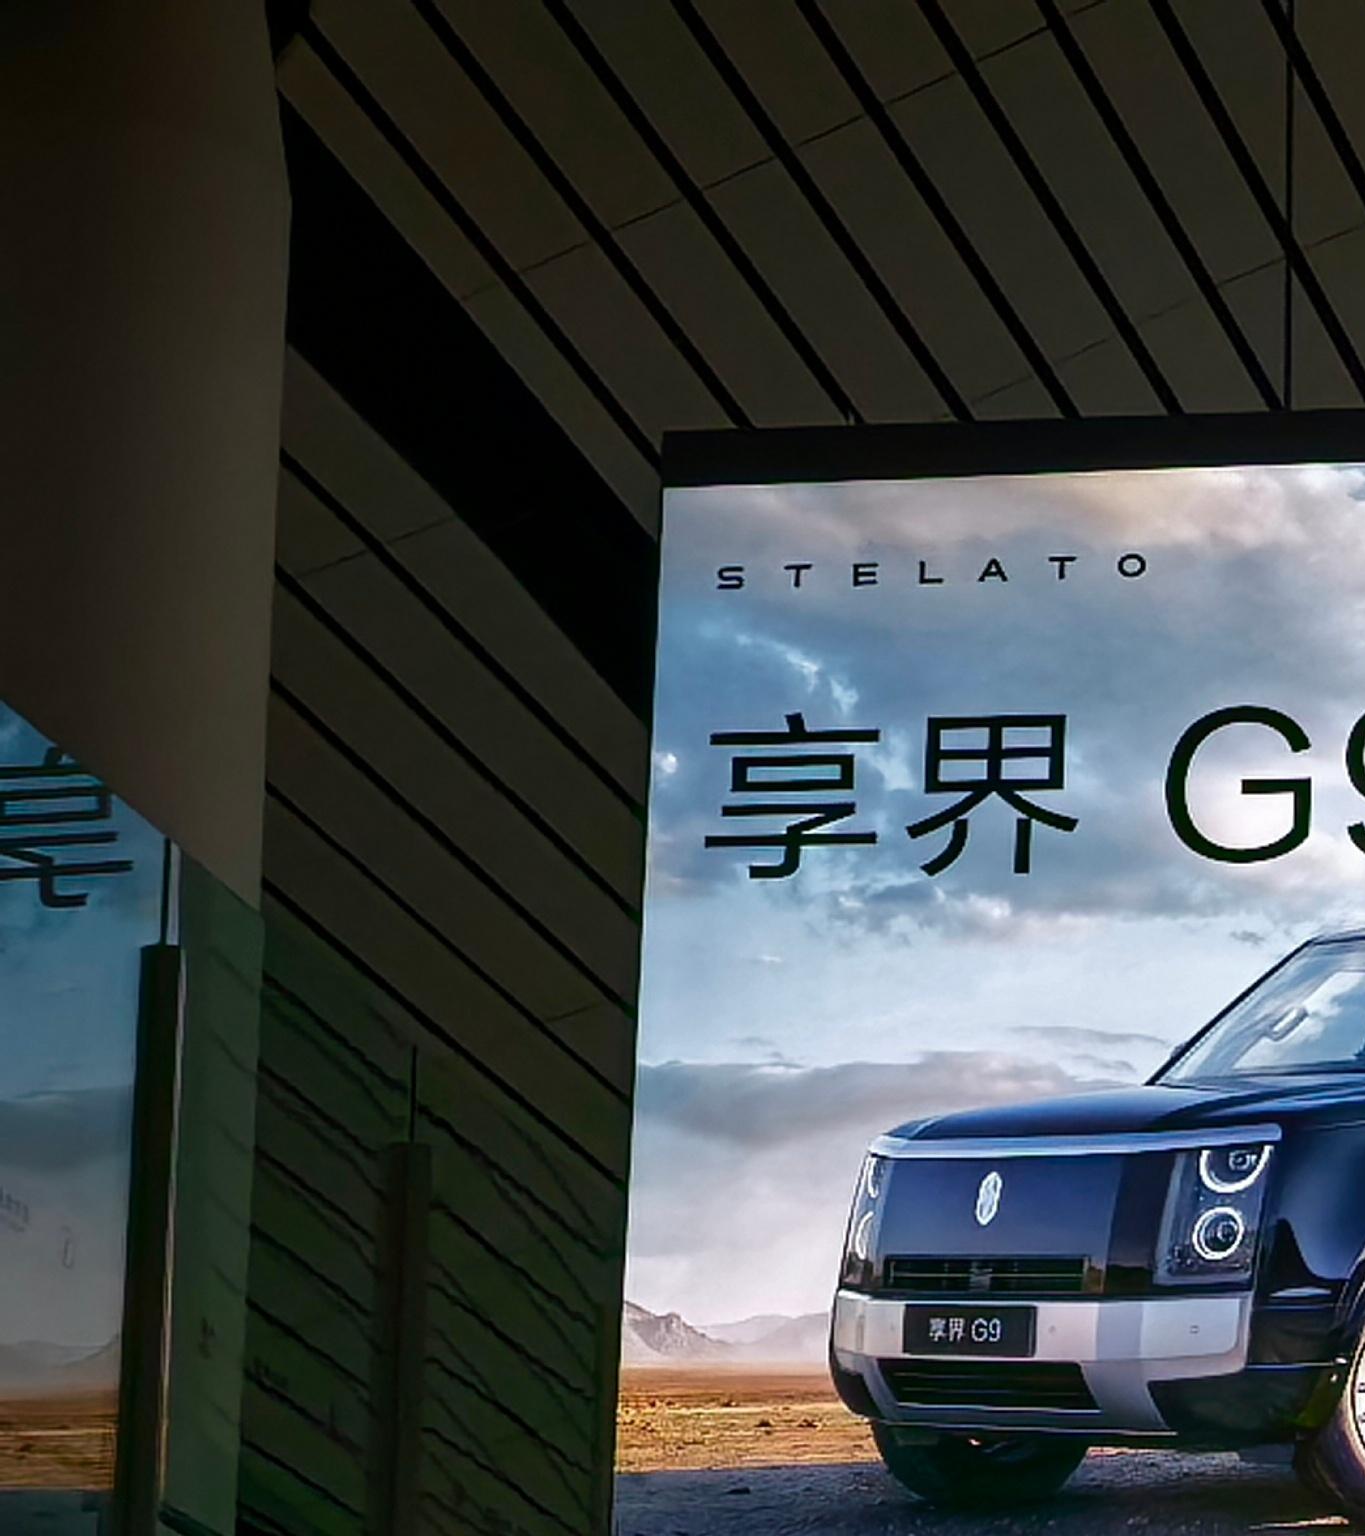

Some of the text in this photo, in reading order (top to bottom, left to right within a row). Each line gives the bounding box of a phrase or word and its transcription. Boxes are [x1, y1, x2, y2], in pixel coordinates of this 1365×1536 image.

[715, 553, 1148, 590] STELATO
[704, 713, 1079, 880] 享界
[971, 1318, 1001, 1341] G9
